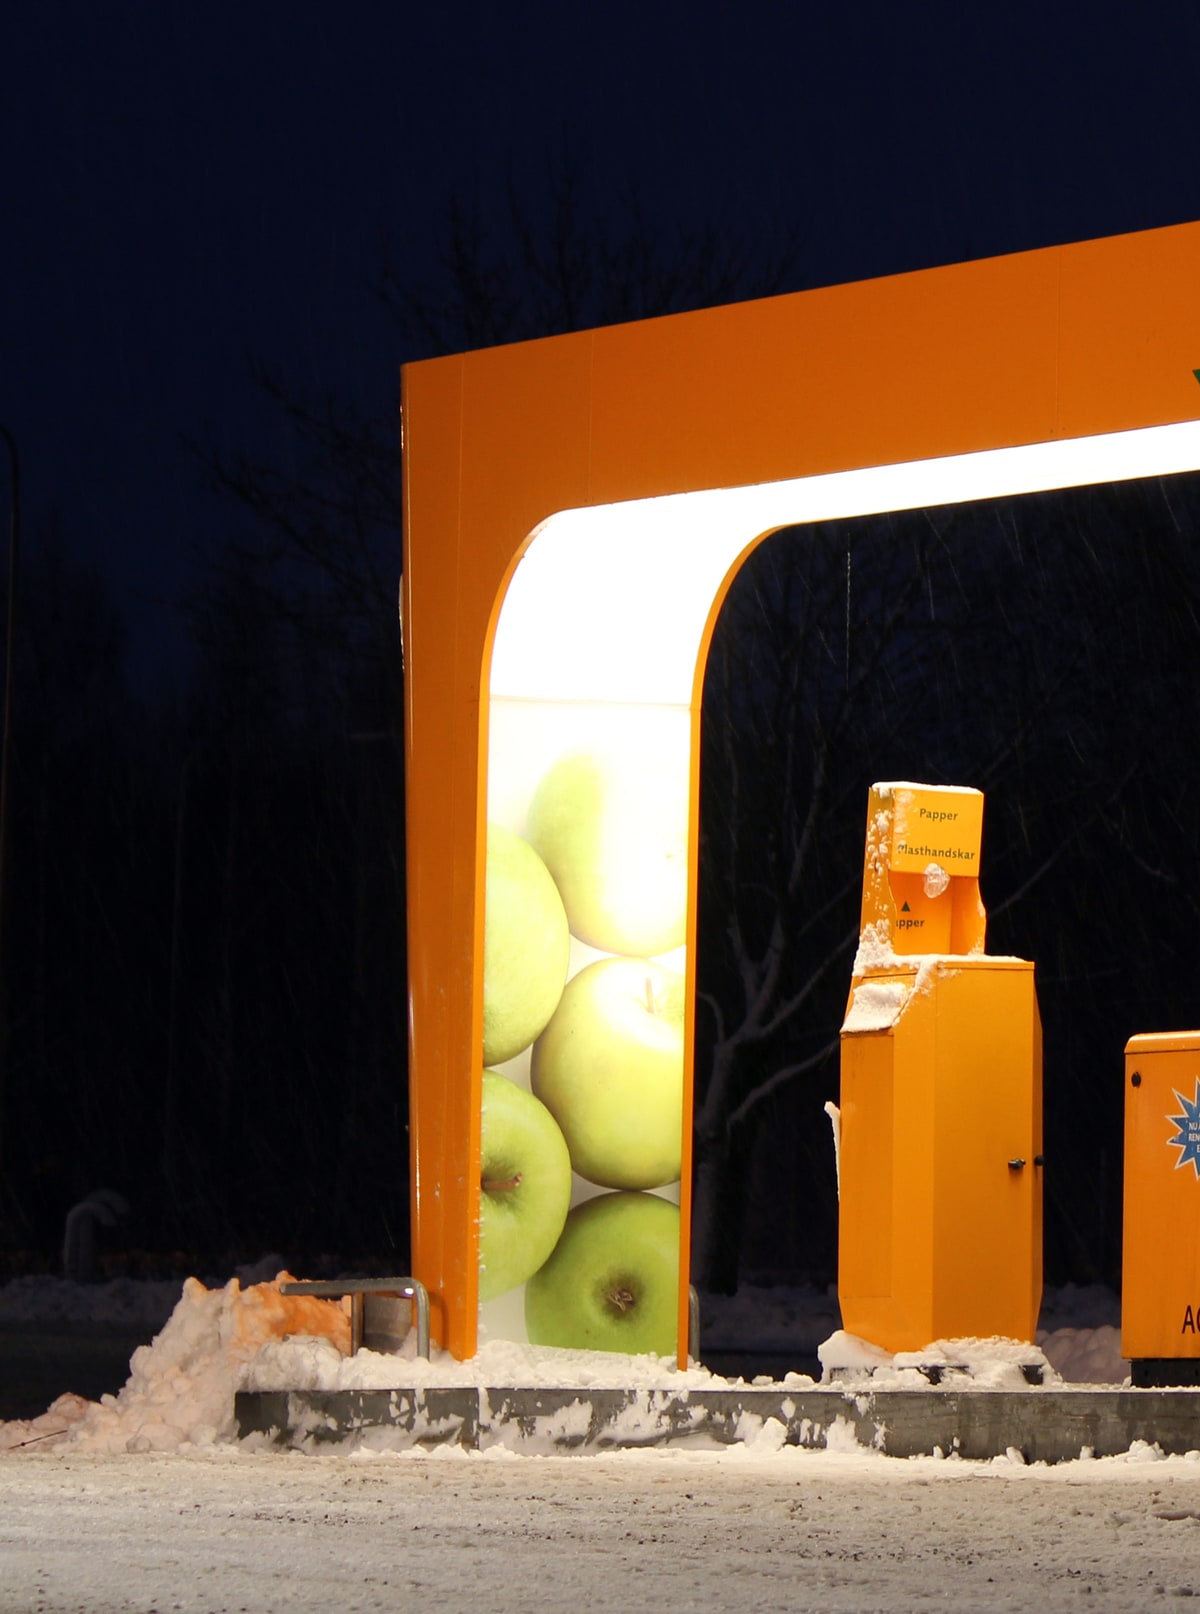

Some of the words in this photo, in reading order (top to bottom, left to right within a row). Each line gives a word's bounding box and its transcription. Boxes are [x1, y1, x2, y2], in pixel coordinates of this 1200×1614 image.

[919, 808, 958, 822] Papper
[896, 919, 925, 930] pper
[1188, 1122, 1198, 1131] NU
